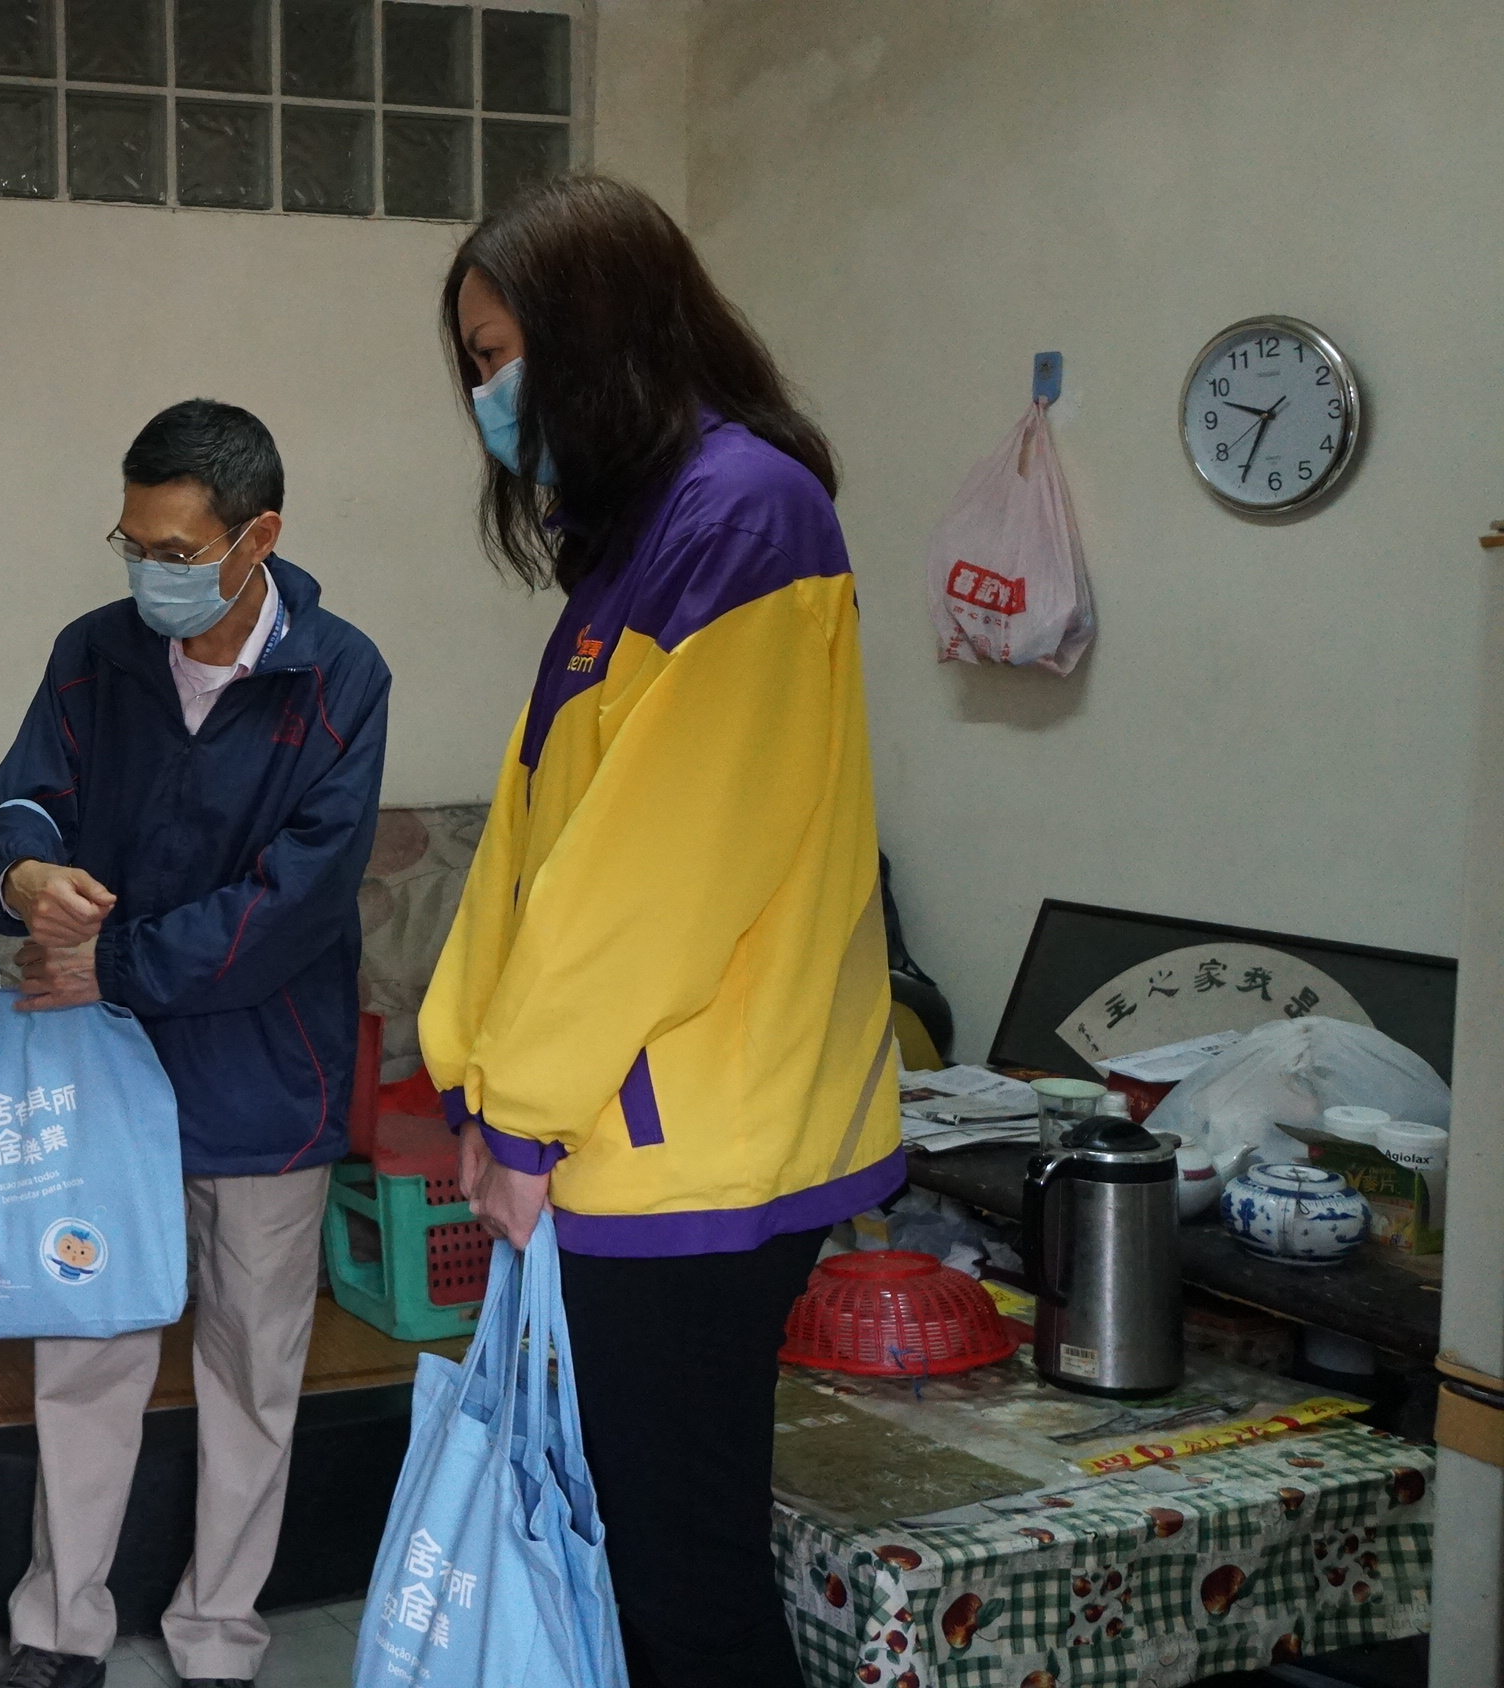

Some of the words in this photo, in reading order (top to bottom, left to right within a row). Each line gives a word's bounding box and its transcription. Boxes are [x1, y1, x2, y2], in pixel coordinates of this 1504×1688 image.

[1255, 336, 1281, 358] 12
[1293, 343, 1304, 363] 1
[1228, 351, 1249, 370] 11
[1315, 366, 1331, 386] 2
[1209, 378, 1230, 397] 10
[1328, 399, 1342, 419] 3
[1204, 411, 1218, 430] 9
[1216, 443, 1229, 461] 8
[1319, 434, 1335, 453] 4
[1298, 460, 1312, 480] 5
[1268, 471, 1282, 491] 6
[33, 1169, 60, 1184] todos
[41, 1182, 63, 1198] para
